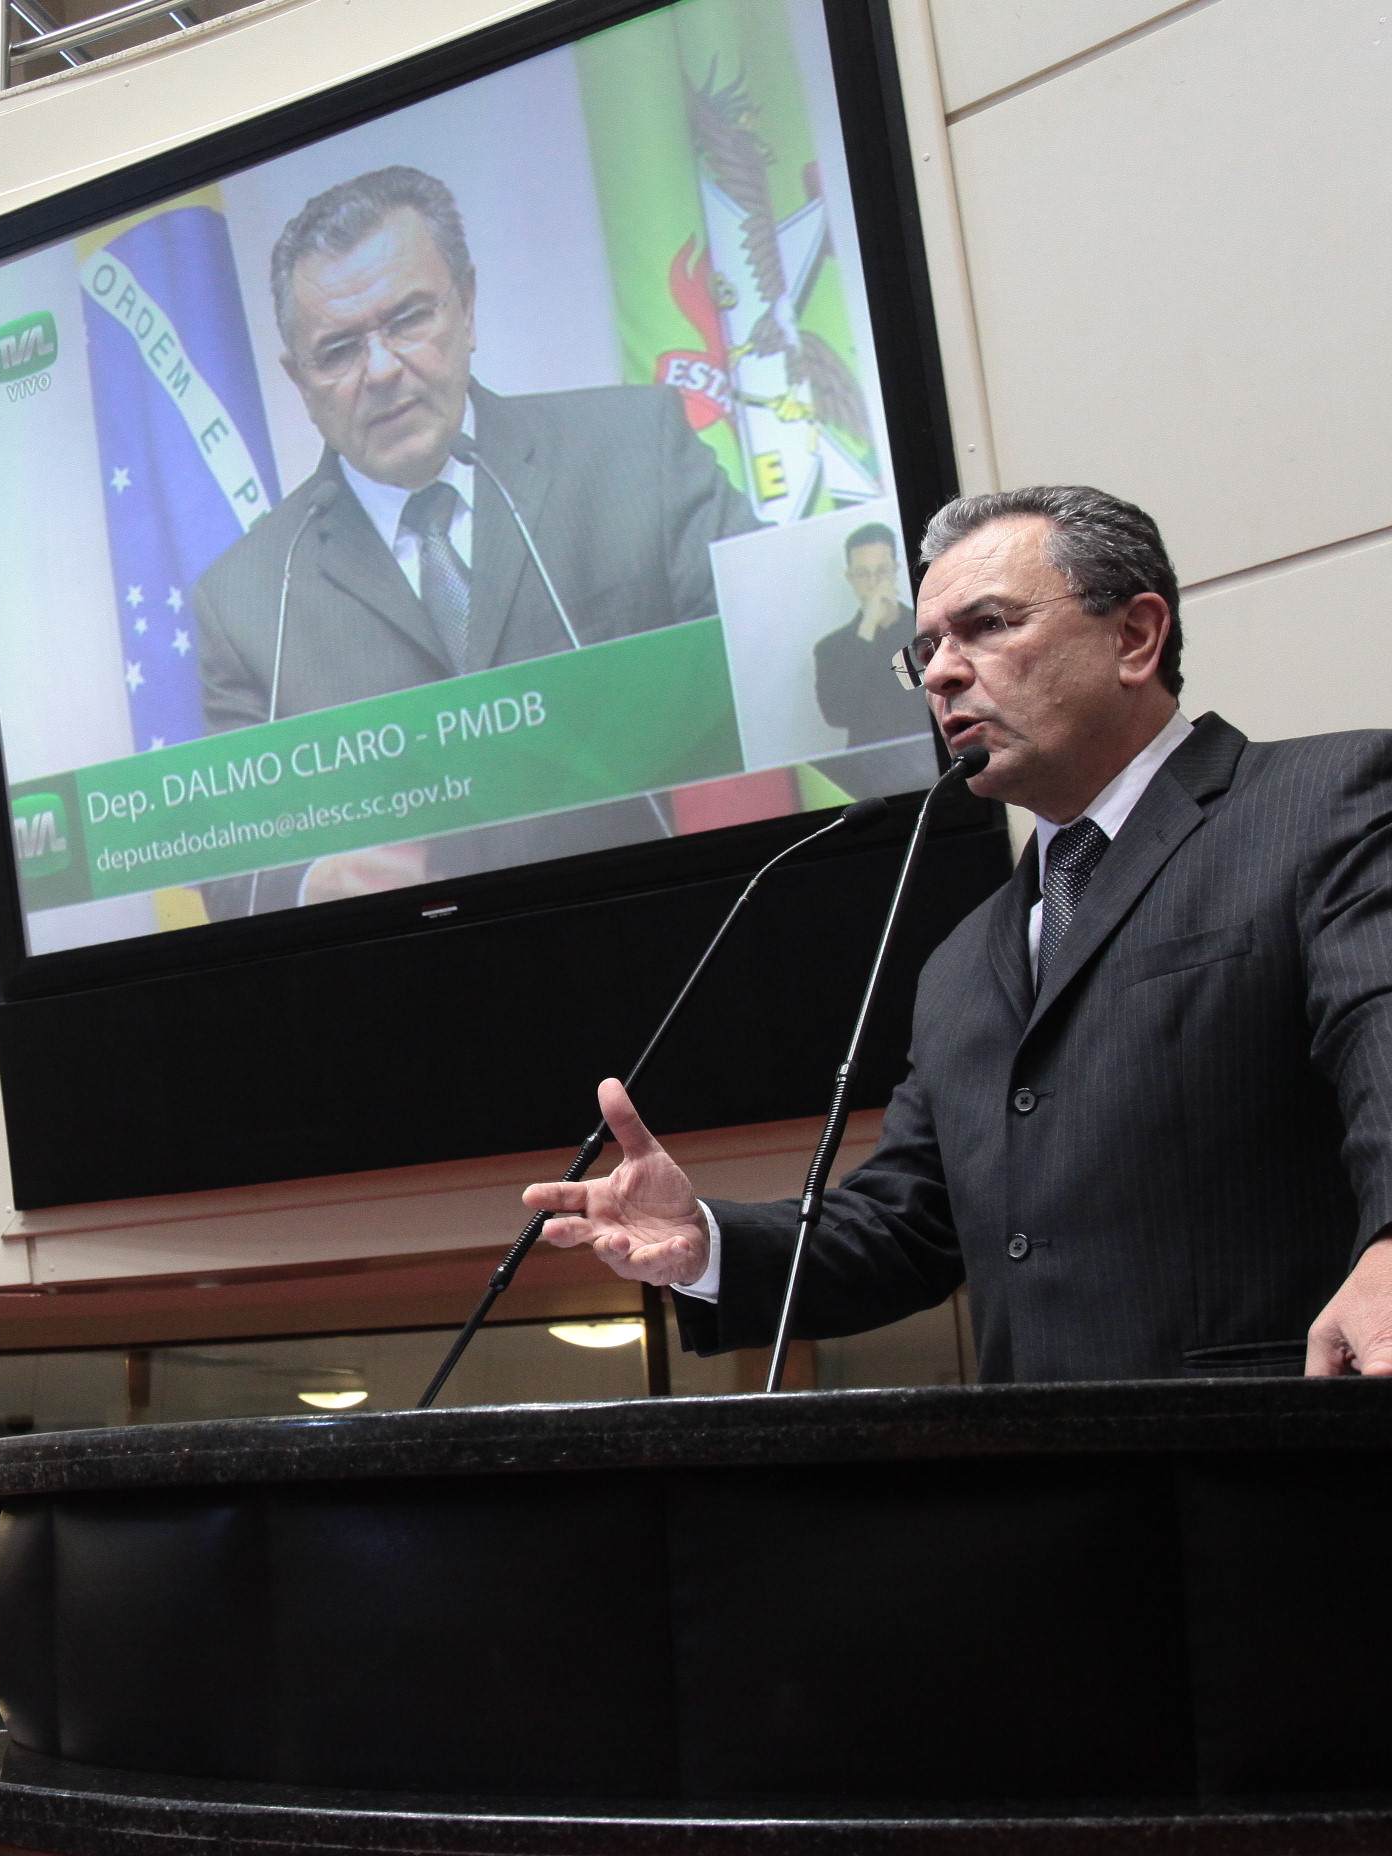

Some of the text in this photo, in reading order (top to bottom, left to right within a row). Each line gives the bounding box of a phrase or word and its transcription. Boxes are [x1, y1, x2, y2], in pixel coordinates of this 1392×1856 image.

[6, 372, 52, 403] VIVO
[91, 263, 192, 398] ORDEM
[200, 416, 230, 455] E
[86, 790, 155, 824] Dep.
[161, 752, 282, 807] DALMO
[290, 723, 406, 777] CLARO
[435, 690, 547, 747] PMDB
[96, 774, 473, 873] deputadodalmo@alesc.sc.gov.br
